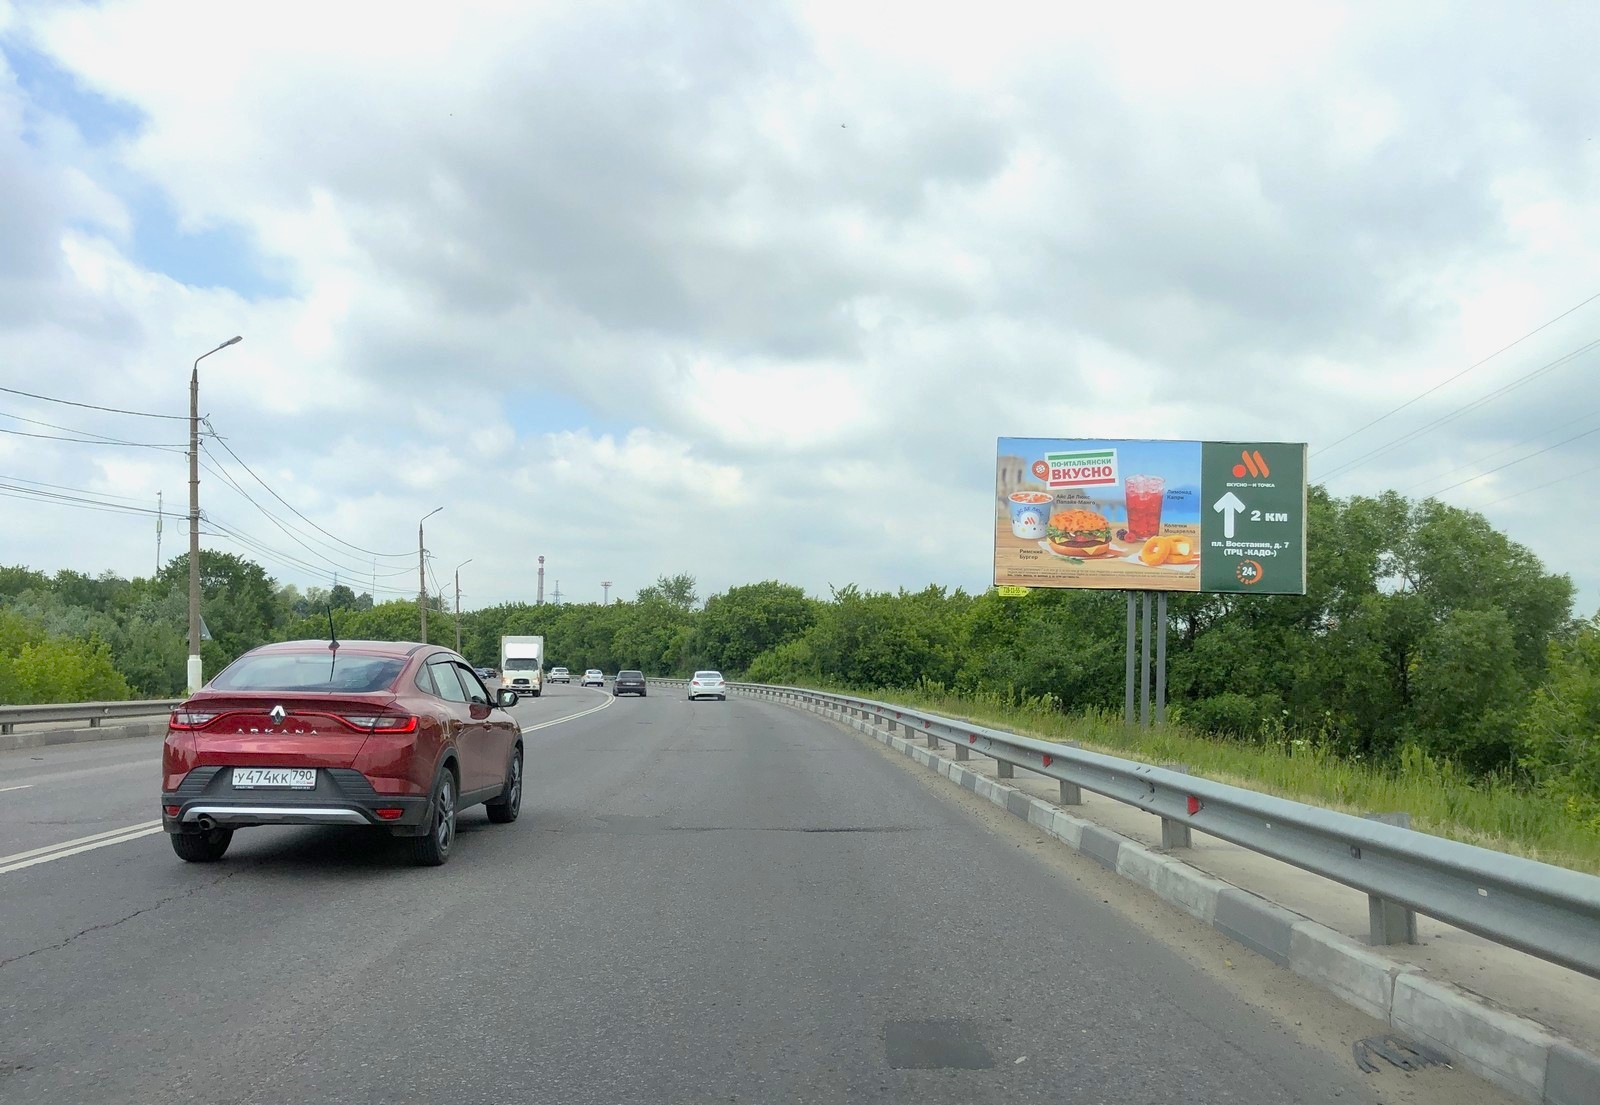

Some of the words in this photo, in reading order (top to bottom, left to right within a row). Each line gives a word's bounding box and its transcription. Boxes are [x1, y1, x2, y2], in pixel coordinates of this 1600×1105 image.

[1051, 459, 1112, 468] ПО-ИТАЛЬЯНСКИ
[1052, 466, 1113, 480] ВКУСНО
[1250, 510, 1261, 522] 2
[1226, 541, 1273, 549] Восстания,
[237, 770, 289, 783] У474КК
[293, 770, 312, 780] 790
